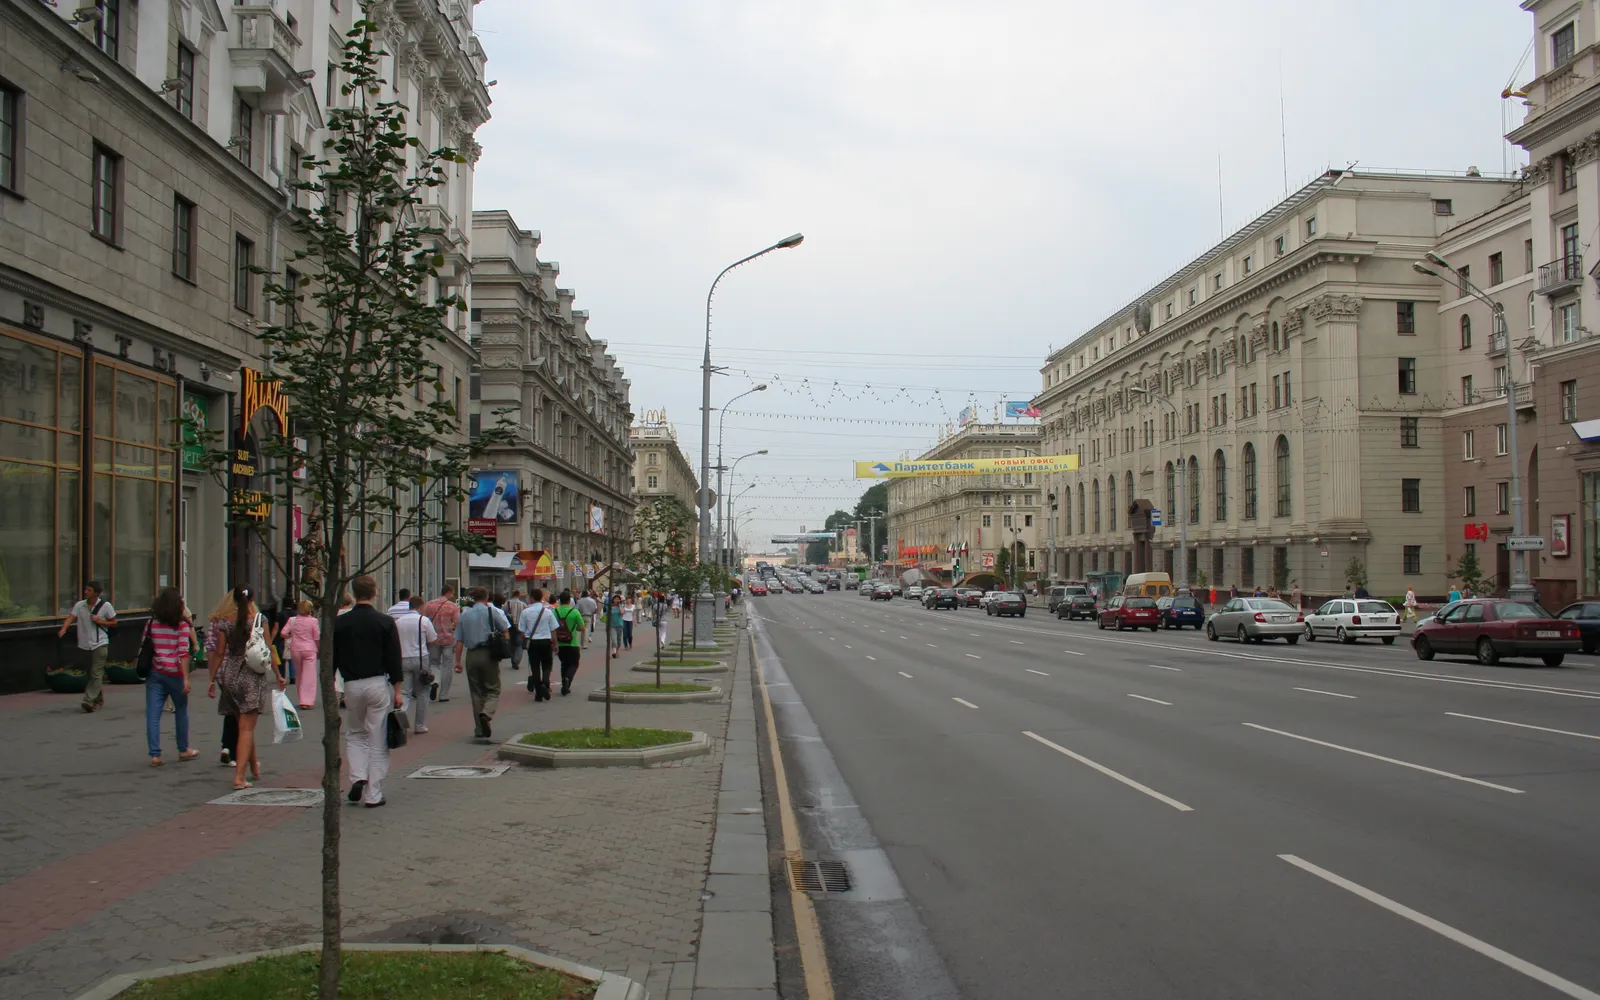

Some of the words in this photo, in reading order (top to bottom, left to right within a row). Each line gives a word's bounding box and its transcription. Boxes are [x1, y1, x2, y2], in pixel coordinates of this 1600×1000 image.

[237, 449, 249, 462] SLOT
[994, 458, 1026, 466] НОВЫЙ
[1030, 457, 1055, 465] ОФИС
[232, 463, 255, 477] MACHINES
[894, 461, 975, 473] Паритетбанк
